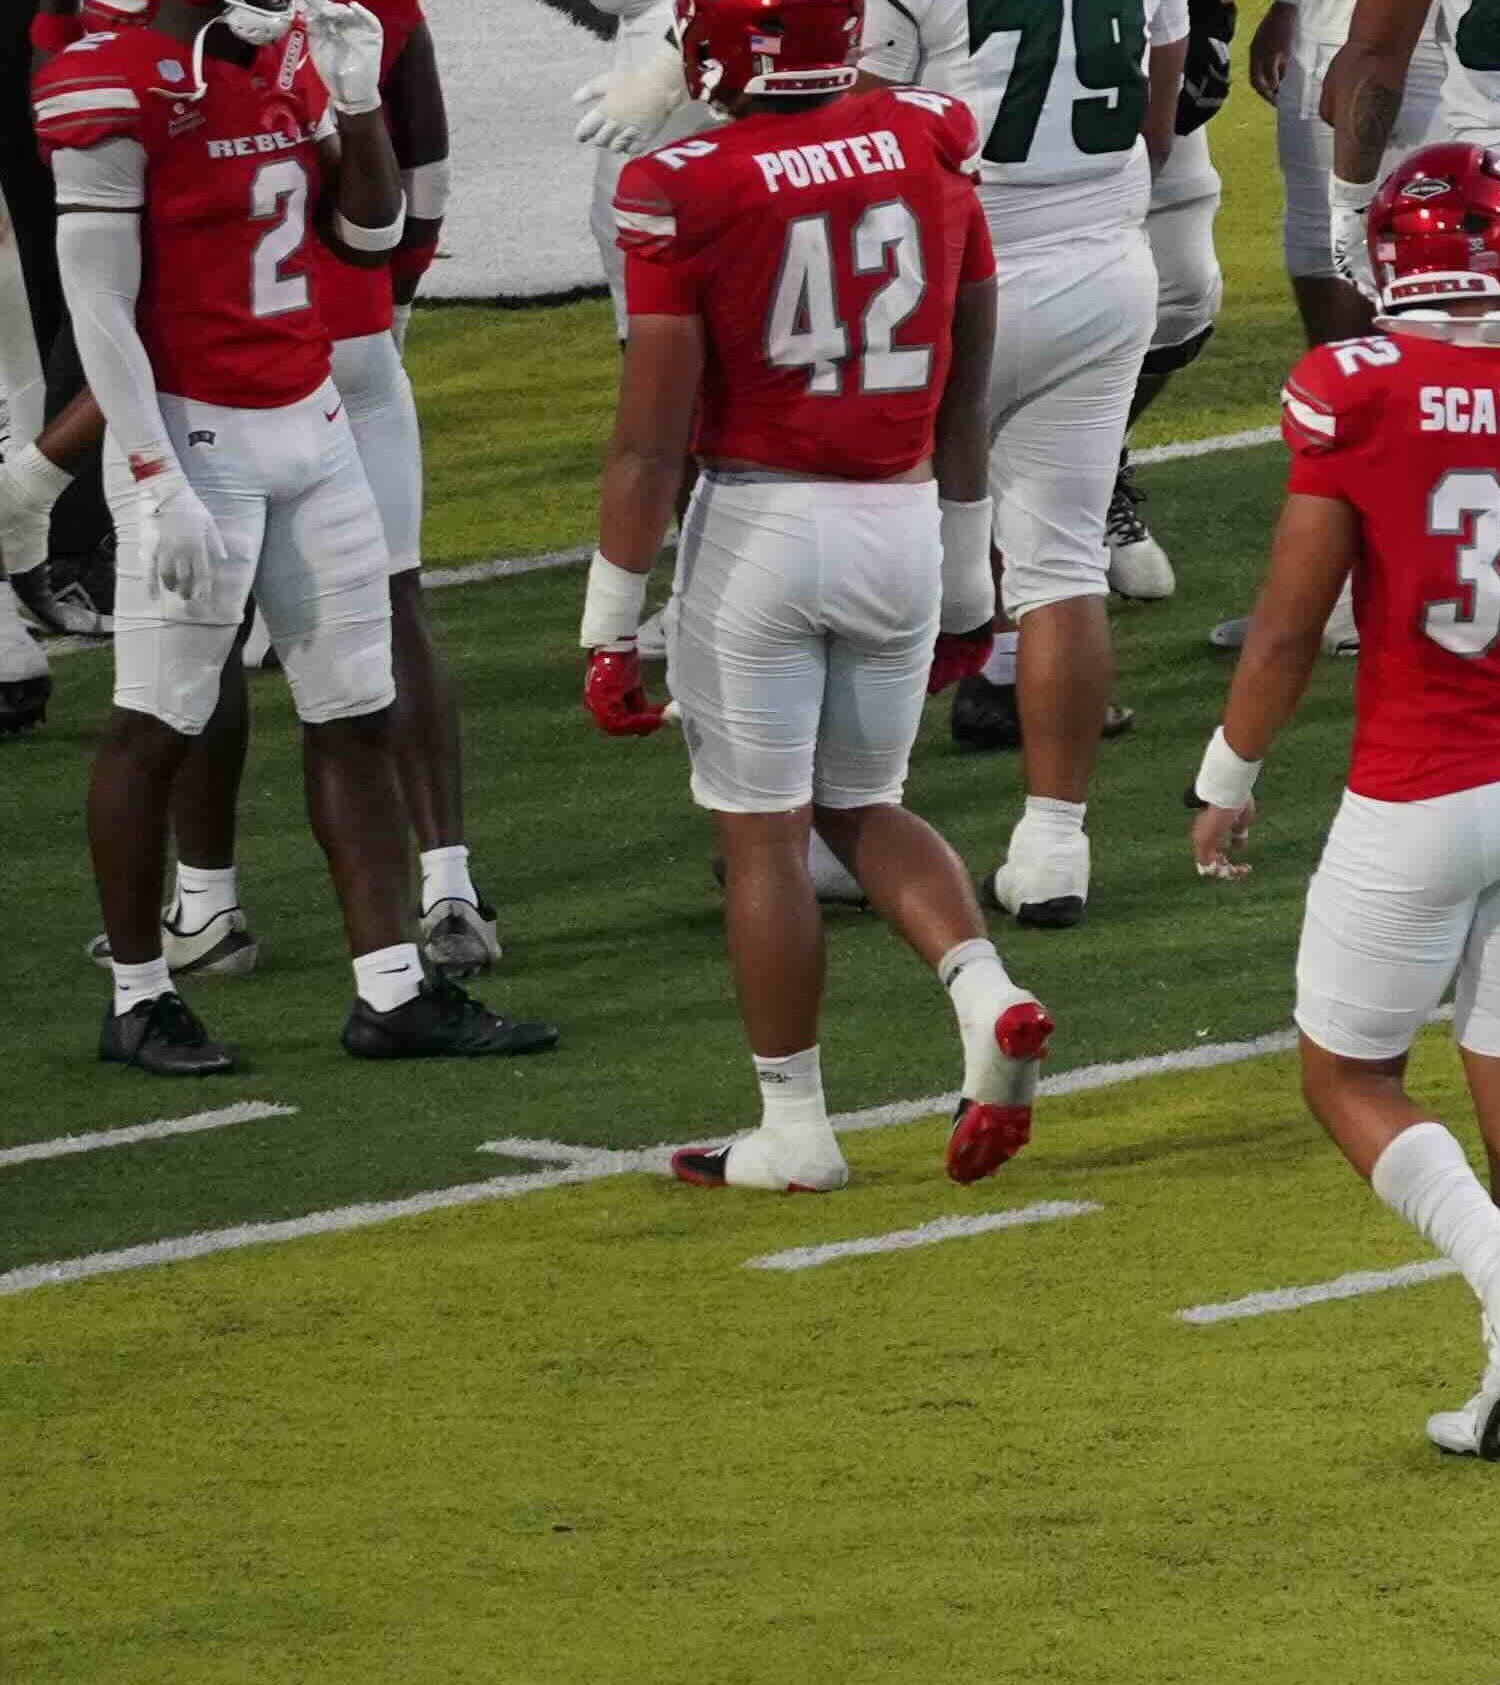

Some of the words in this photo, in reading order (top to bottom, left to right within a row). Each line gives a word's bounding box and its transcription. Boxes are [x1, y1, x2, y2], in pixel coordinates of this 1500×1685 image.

[249, 156, 312, 319] 2
[752, 130, 906, 193] PORTER
[764, 197, 936, 396] 42
